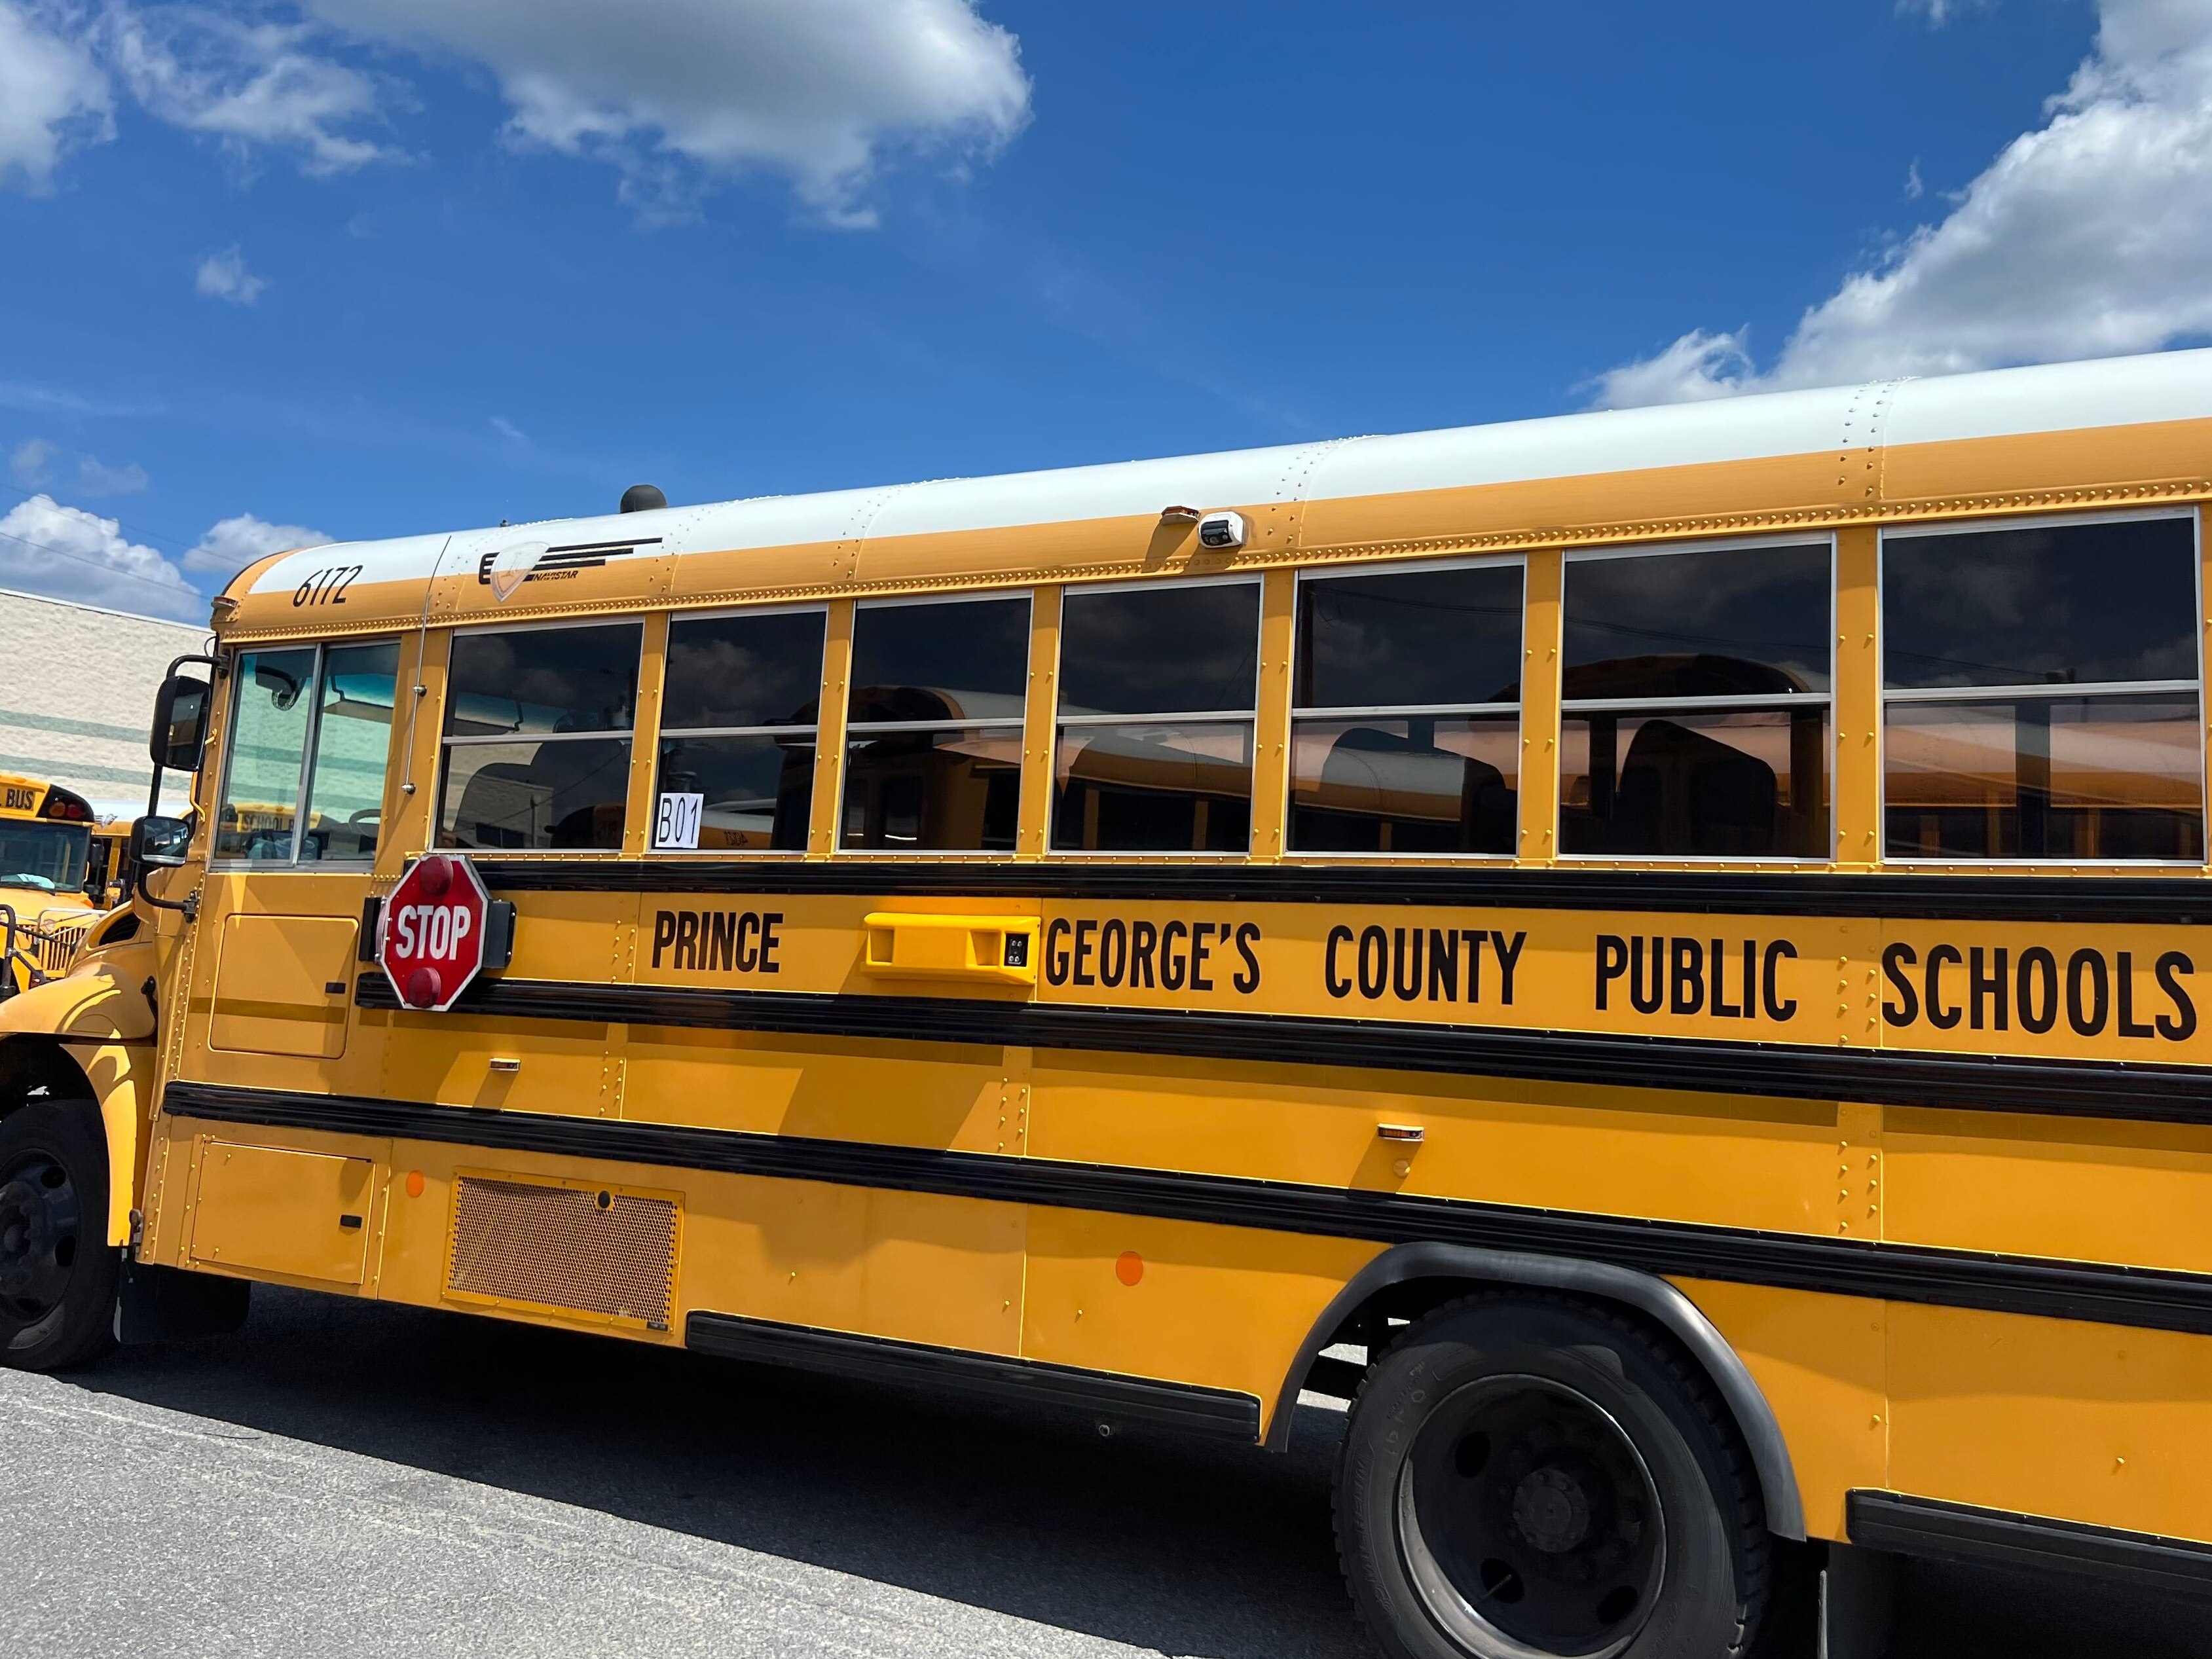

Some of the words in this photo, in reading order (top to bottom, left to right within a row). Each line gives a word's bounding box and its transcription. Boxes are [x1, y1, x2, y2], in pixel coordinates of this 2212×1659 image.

[293, 565, 363, 607] 6172
[533, 570, 579, 581] NAVISTAR
[6, 788, 34, 810] BUS
[659, 797, 699, 844] B01
[396, 905, 471, 960] STOP
[652, 910, 784, 973] PRINCE
[1046, 918, 1261, 994] GEORGE'S
[1325, 924, 1527, 1006] COUNTY
[1595, 934, 1798, 1021] PUBLIC
[1881, 942, 2197, 1042] SCHOOLS
